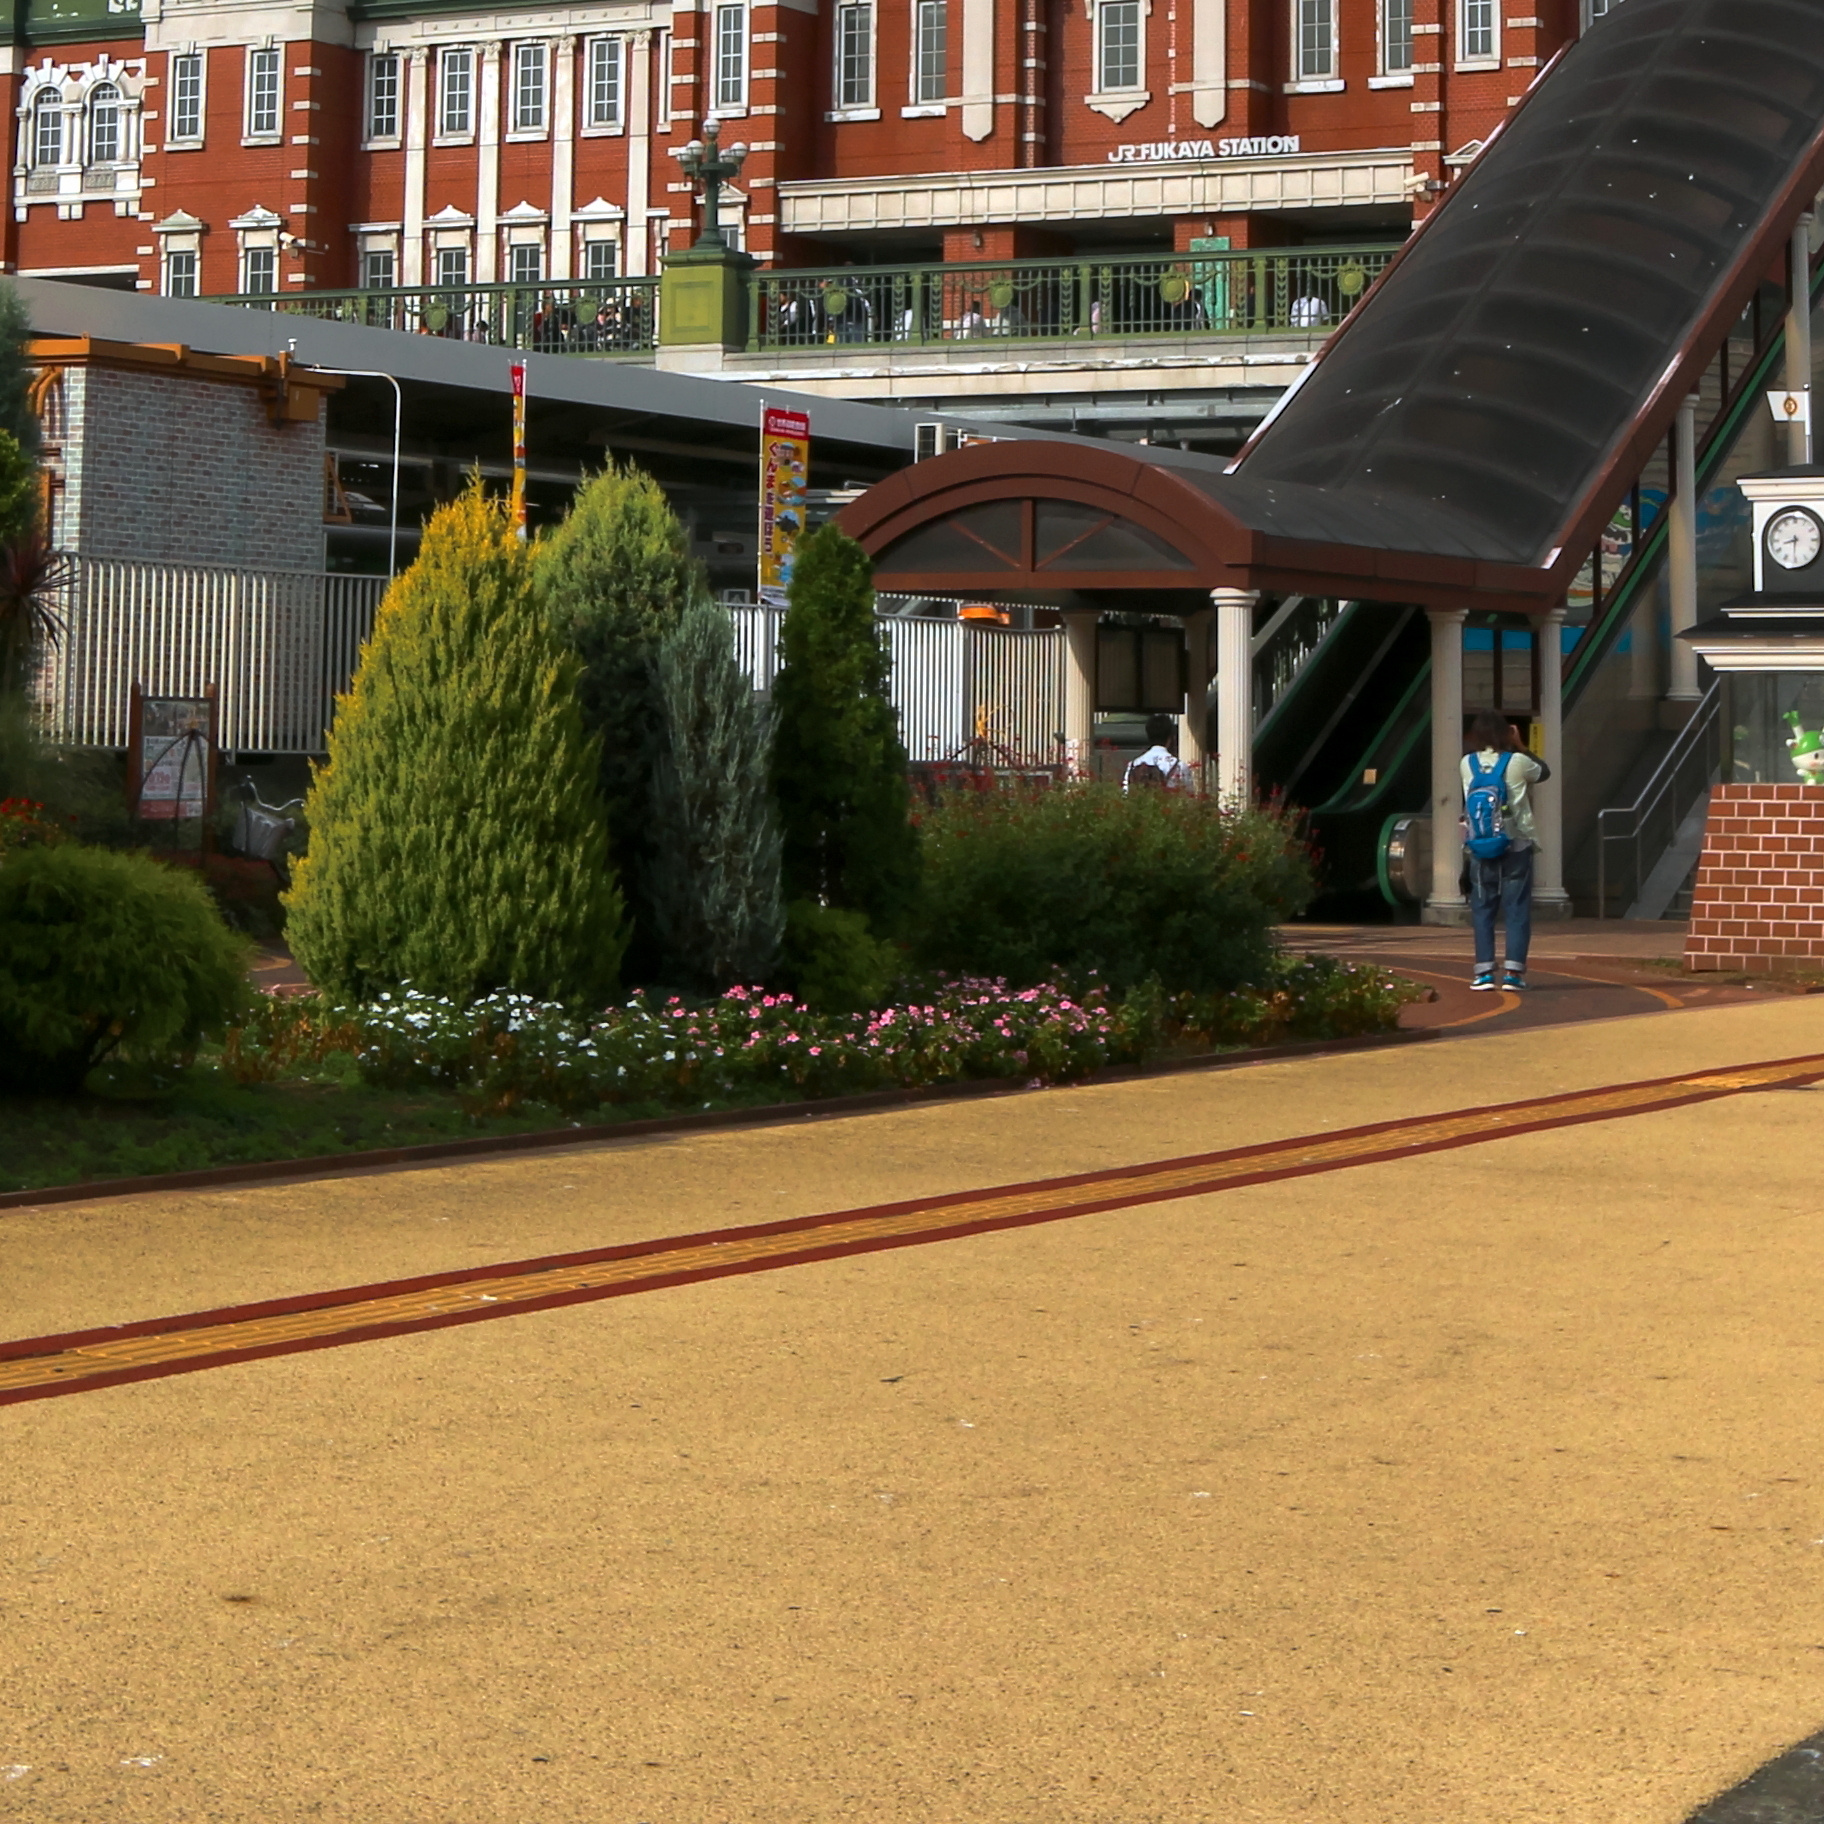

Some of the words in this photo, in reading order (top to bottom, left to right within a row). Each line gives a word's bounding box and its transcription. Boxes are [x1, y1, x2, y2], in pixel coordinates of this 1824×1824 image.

[1108, 145, 1135, 162] JR
[1139, 139, 1214, 160] FUKAYA
[1219, 135, 1300, 156] STATION
